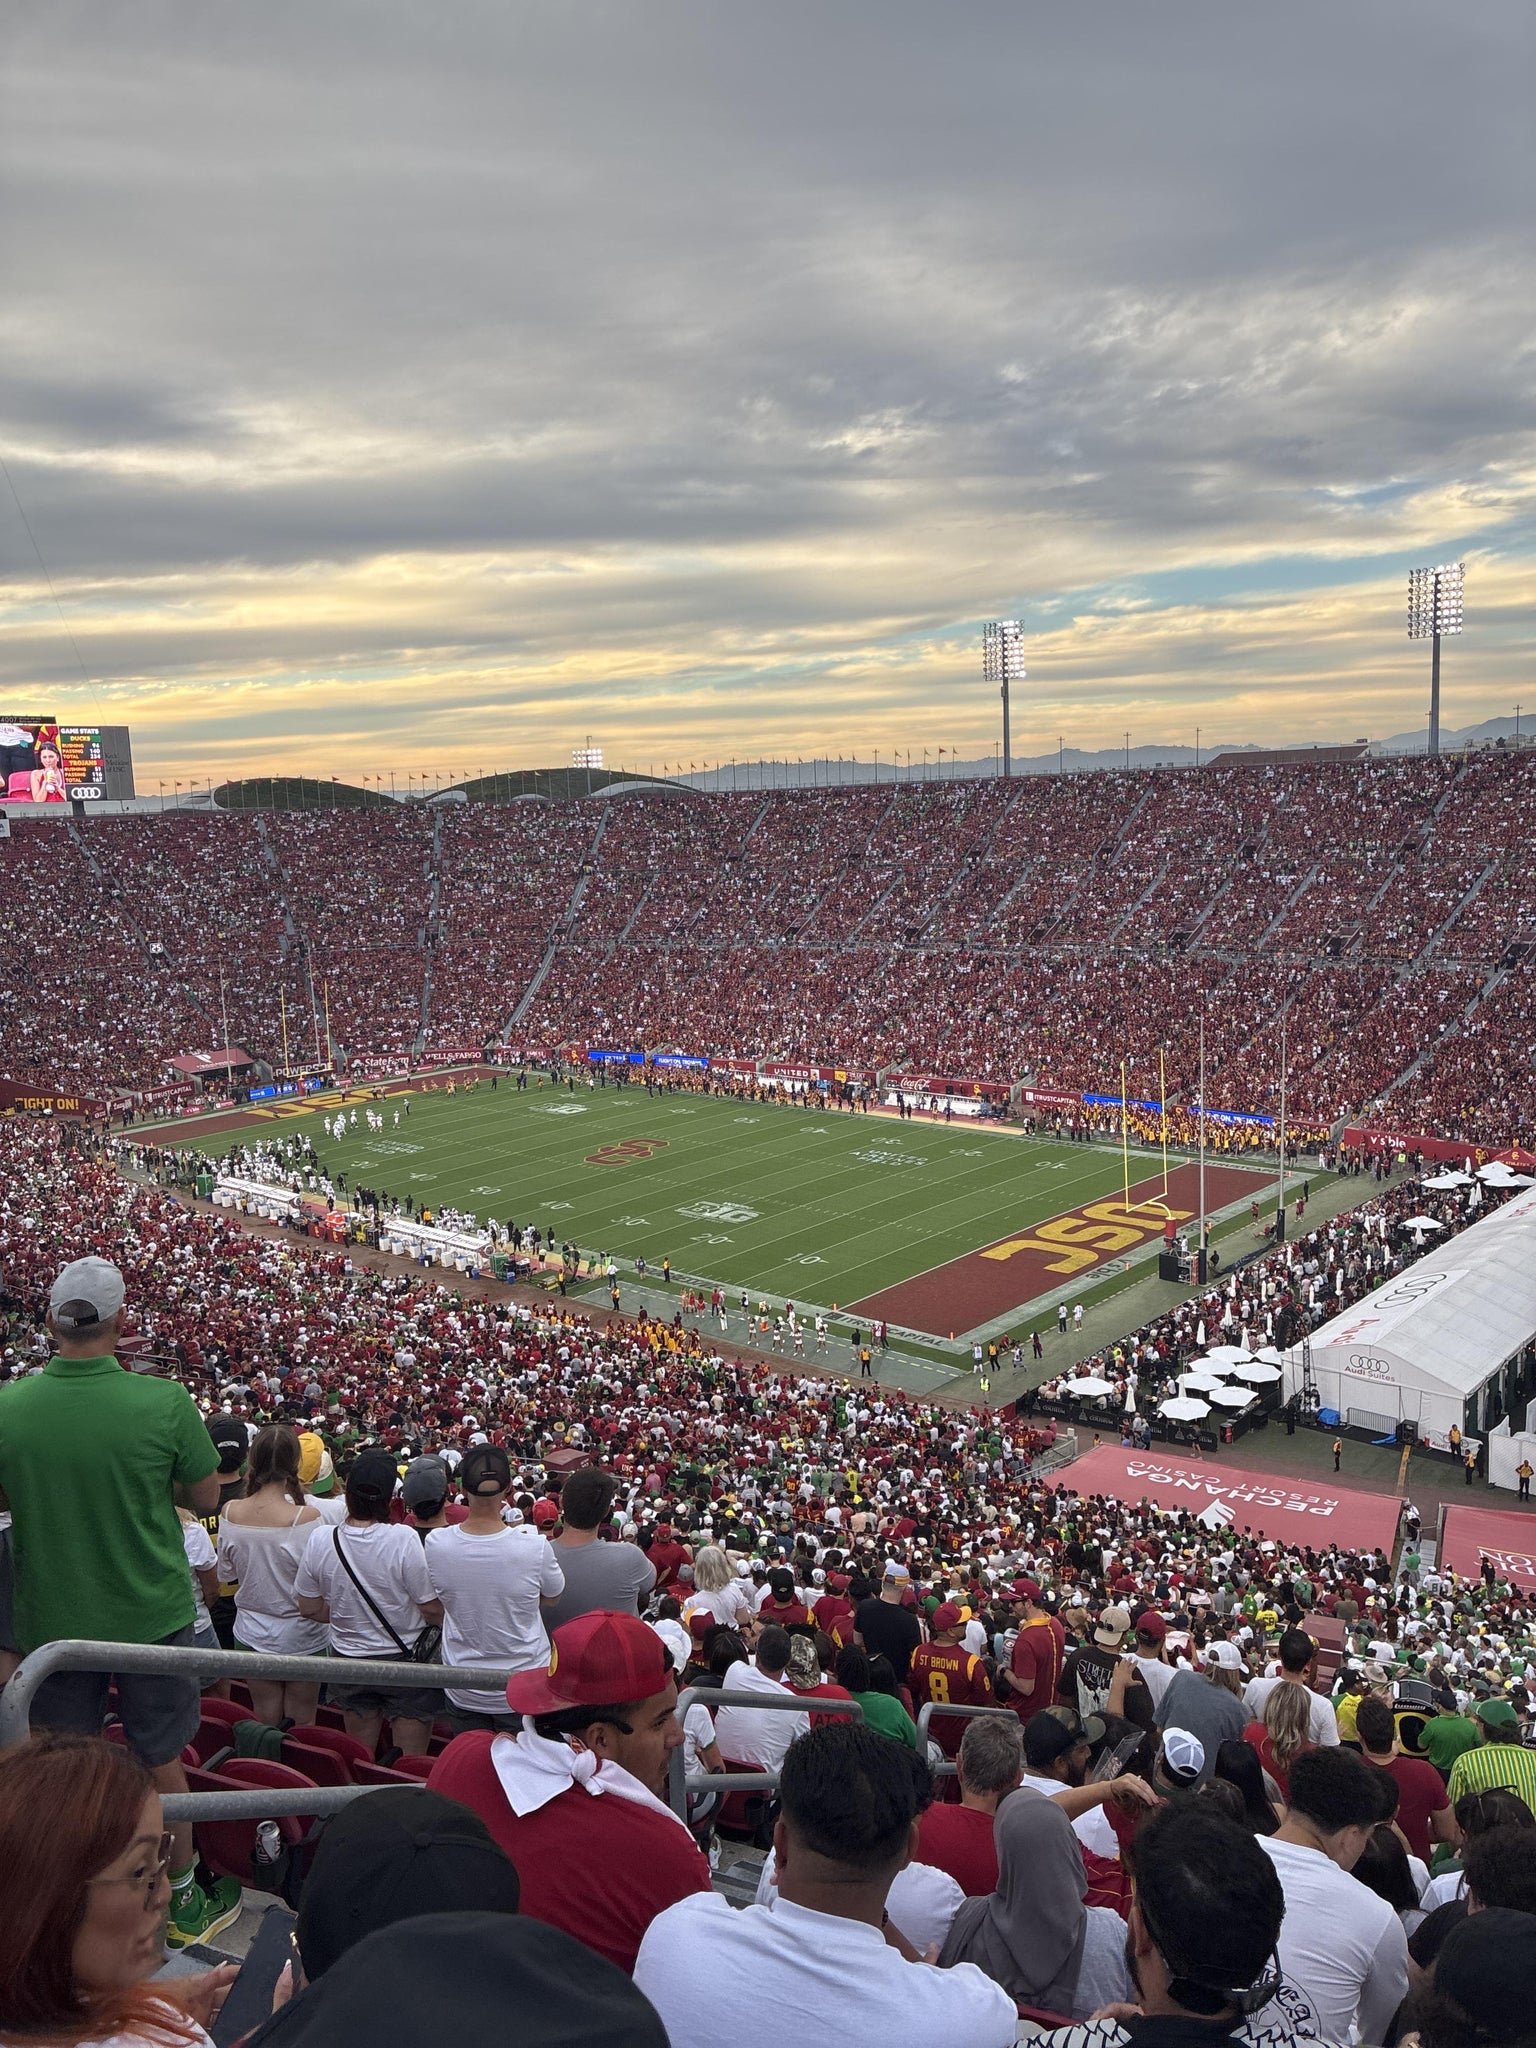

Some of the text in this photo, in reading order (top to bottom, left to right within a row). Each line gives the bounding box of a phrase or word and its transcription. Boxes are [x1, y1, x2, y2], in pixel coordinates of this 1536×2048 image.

[364, 1057, 387, 1067] State
[425, 1051, 482, 1061] WELLS FARGO
[773, 1068, 809, 1077] UNITED
[57, 1098, 80, 1111] ON!
[978, 1201, 1195, 1274] USC
[1326, 1318, 1381, 1348] Audi
[1344, 1365, 1396, 1383] Audi Suites
[1129, 1460, 1221, 1485] CASINO
[1126, 1466, 1336, 1516] PECHANGA
[1234, 1483, 1339, 1507] RESORT
[919, 1654, 959, 1671] ST BROWN
[928, 1670, 951, 1705] 8
[983, 1675, 991, 1692] 8
